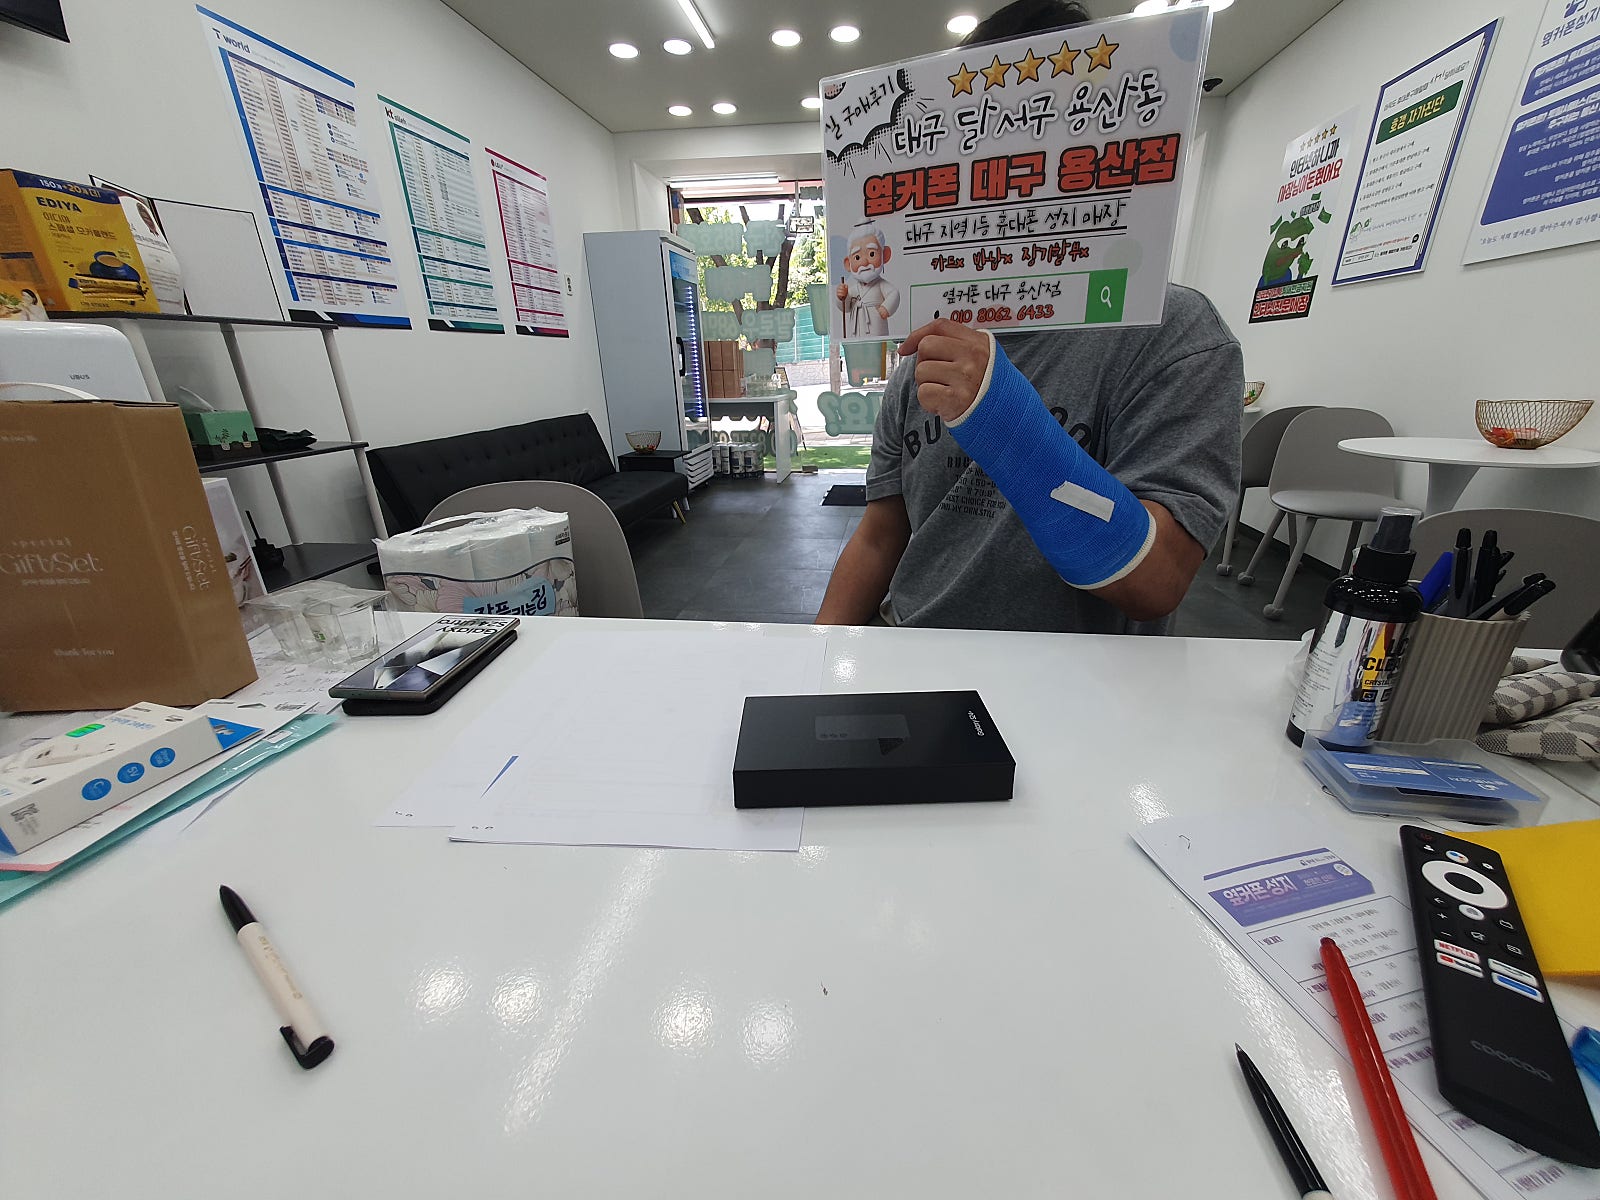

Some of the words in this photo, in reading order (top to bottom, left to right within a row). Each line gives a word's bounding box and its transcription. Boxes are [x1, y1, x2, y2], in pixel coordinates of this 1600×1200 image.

[212, 27, 221, 40] T
[222, 34, 251, 54] world
[842, 75, 895, 127] 구매후기
[894, 113, 946, 154] 대구
[957, 95, 1055, 150] 달서구
[1067, 72, 1164, 134] 용산동
[1406, 95, 1446, 125] 자가진단
[863, 163, 960, 217] 옆커폰
[970, 151, 1047, 201] 대구
[1058, 133, 1181, 193] 용산점
[36, 196, 82, 213] EDIYA
[906, 221, 935, 244] 대구
[940, 220, 968, 240] 지역
[996, 209, 1039, 239] 휴대폰
[1045, 206, 1076, 231] 성지
[1082, 199, 1127, 227] 매장
[943, 284, 981, 305] 옆커폰
[985, 285, 1012, 301] 대구
[1016, 280, 1062, 301] 용산점
[950, 308, 973, 324] 010
[977, 306, 1012, 323] 8062
[1016, 304, 1055, 321] 6433
[435, 625, 498, 636] Galaxy
[1265, 874, 1299, 897] 성지
[1439, 942, 1476, 959] NETFLIX
